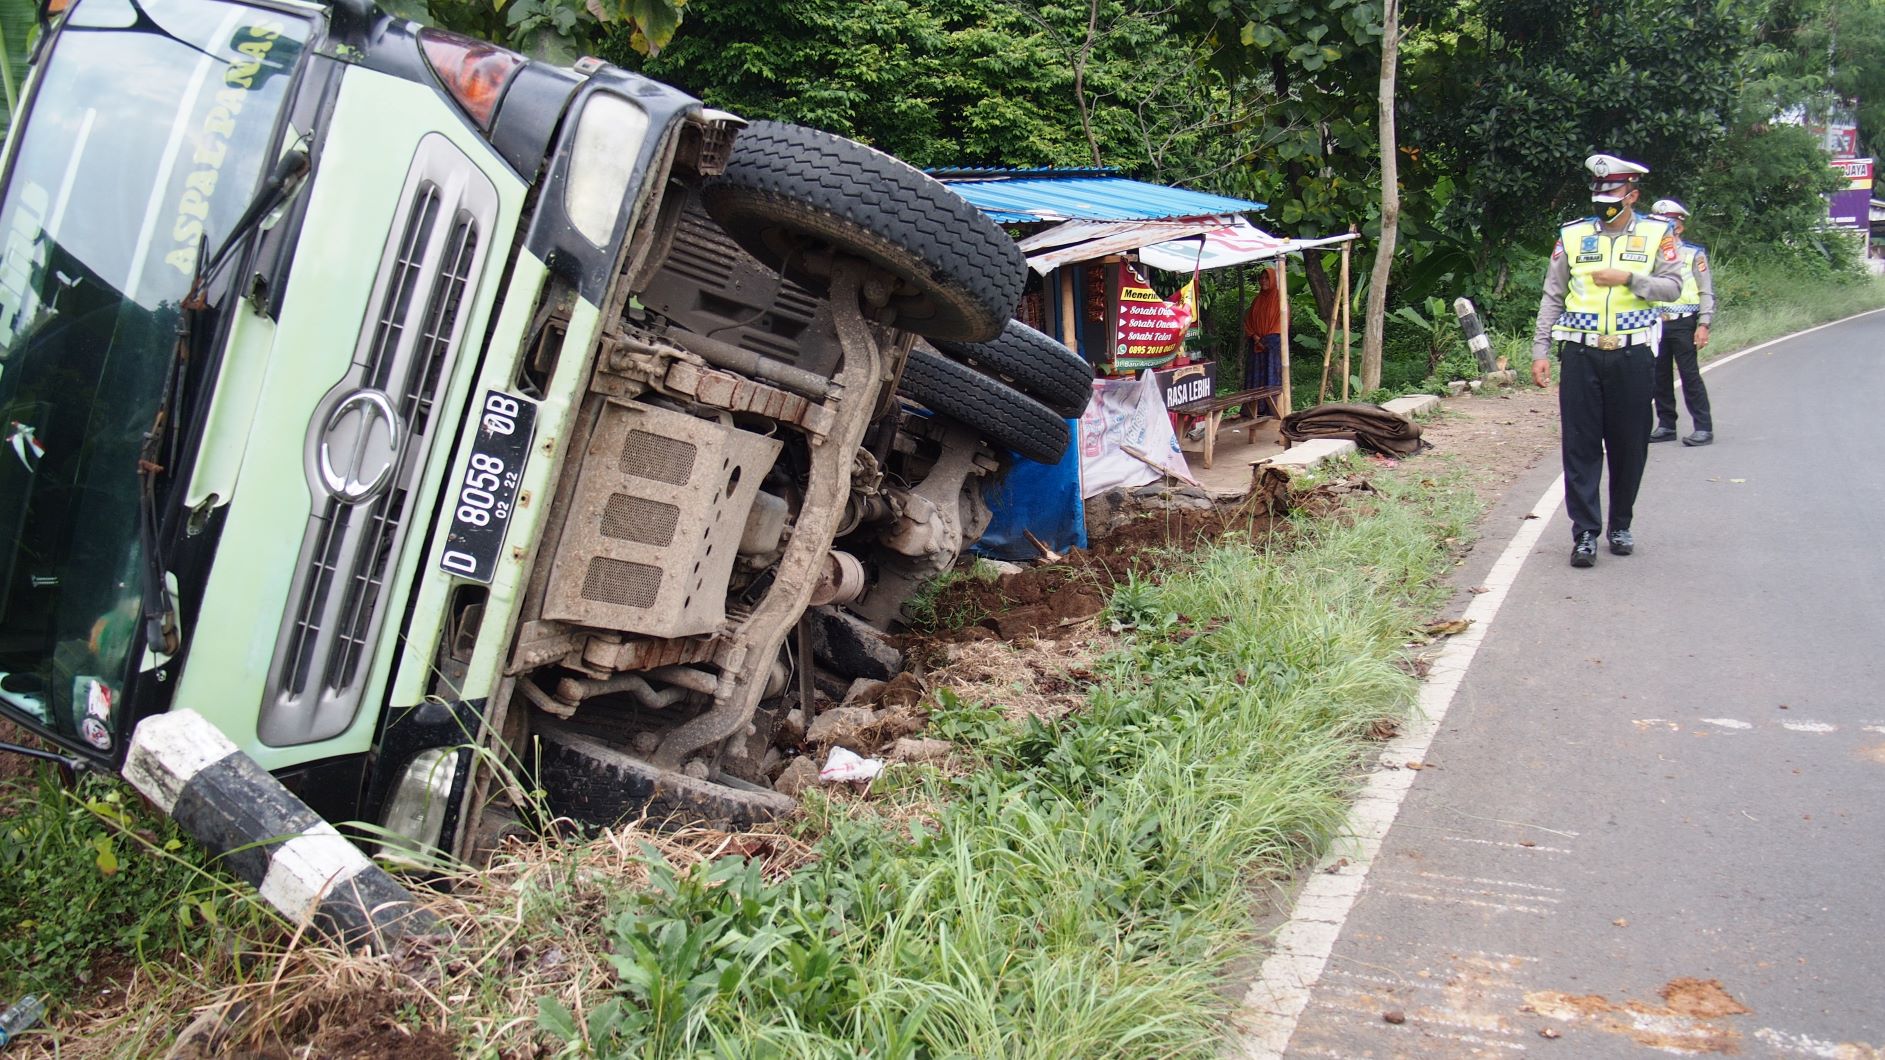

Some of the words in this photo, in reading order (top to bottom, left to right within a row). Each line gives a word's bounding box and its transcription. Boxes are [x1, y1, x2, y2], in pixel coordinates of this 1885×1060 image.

[1845, 164, 1867, 176] JAYA
[1129, 306, 1156, 316] Sorabi
[1128, 319, 1155, 328] Sorabi
[1127, 332, 1153, 341] Sorabi
[1154, 332, 1172, 341] Telor
[1128, 345, 1146, 354] 0895
[1166, 384, 1187, 408] RASA
[1188, 377, 1211, 399] LEBIH
[457, 453, 504, 527] 8058
[442, 550, 477, 573] D
